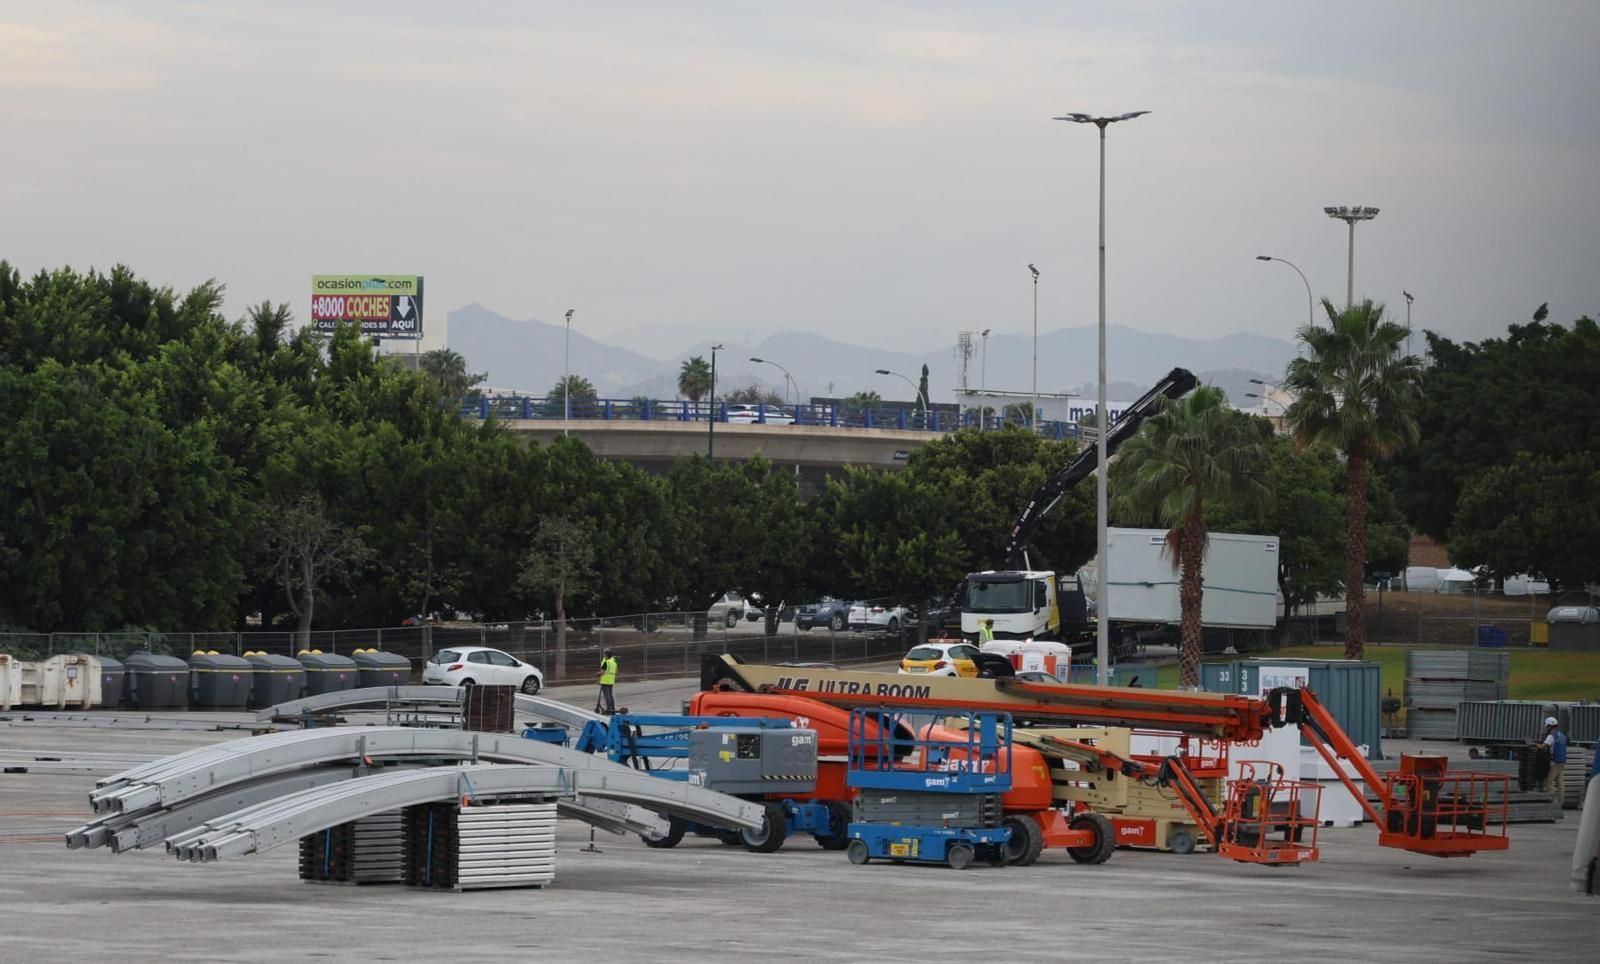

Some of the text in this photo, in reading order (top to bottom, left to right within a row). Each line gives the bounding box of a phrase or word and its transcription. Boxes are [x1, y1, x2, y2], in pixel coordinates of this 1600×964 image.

[317, 278, 412, 290] ocasionplus.com
[313, 296, 390, 318] +8000 COCHES
[318, 321, 336, 329] CALL
[392, 319, 414, 330] AQUÍ
[1220, 671, 1229, 681] 33
[877, 683, 930, 699] BOOM
